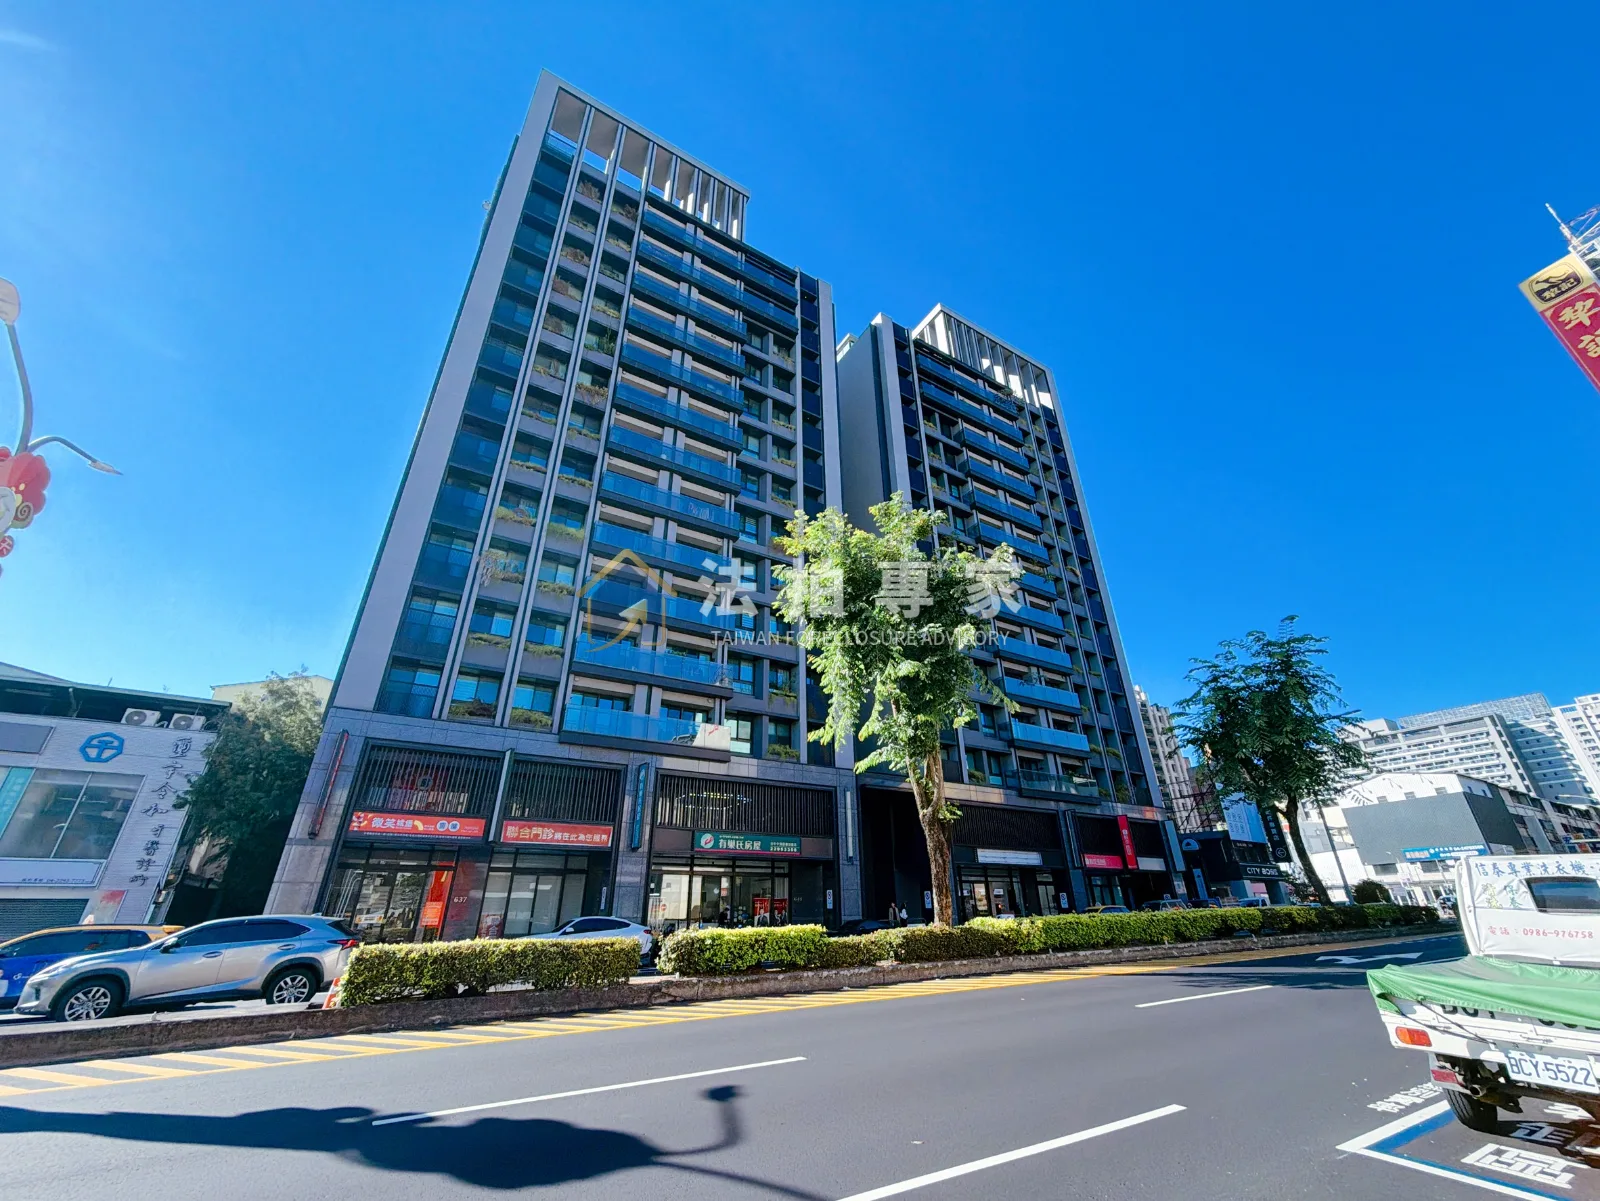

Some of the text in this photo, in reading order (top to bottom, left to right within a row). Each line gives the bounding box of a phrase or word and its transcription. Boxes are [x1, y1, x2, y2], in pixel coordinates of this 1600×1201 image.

[719, 839, 761, 851] 有巢氏房屋
[1522, 928, 1593, 939] 0986-976758
[1507, 1056, 1596, 1088] BCY-5522
